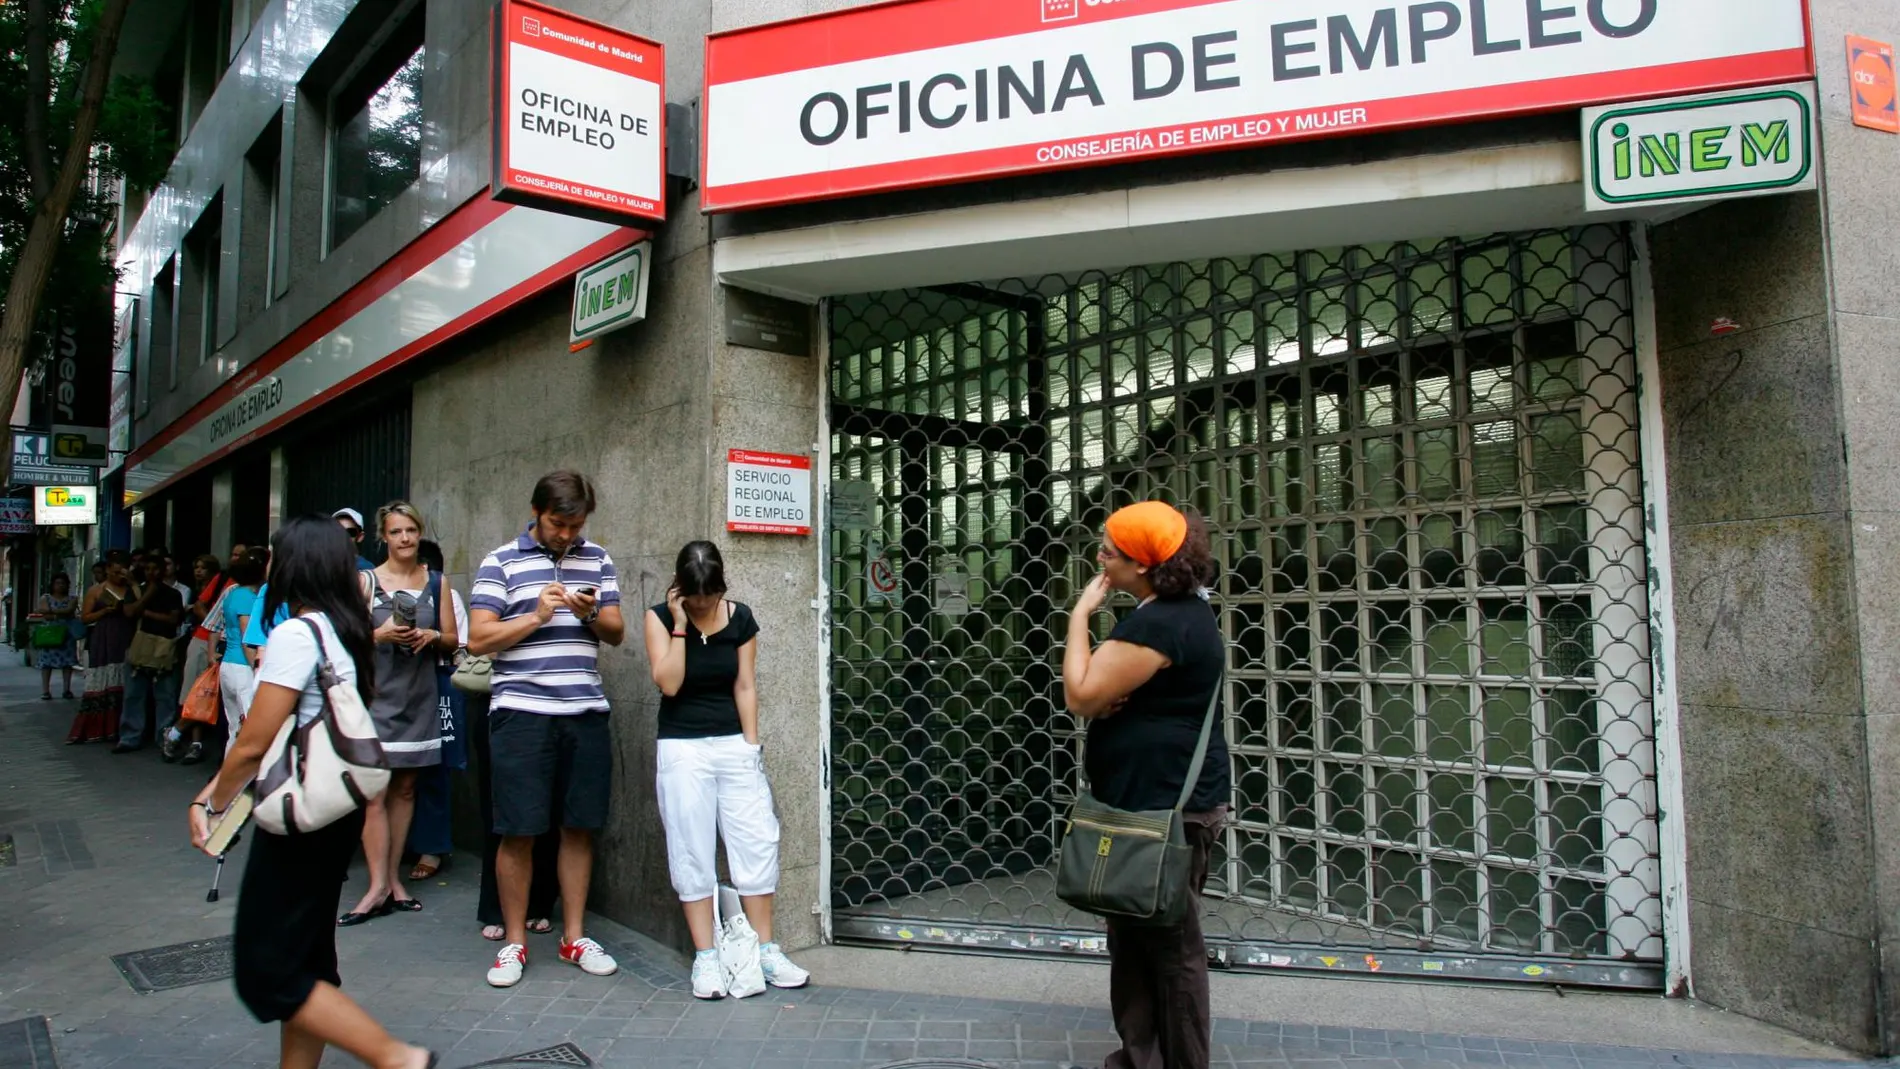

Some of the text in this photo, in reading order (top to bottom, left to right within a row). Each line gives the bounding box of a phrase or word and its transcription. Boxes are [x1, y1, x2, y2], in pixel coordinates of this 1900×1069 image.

[542, 26, 643, 63] Comunidad de Madrid
[799, 0, 1658, 146] OFICINA DE EMPLEO
[521, 88, 648, 136] OFICINA DE
[521, 111, 615, 150] EMPLEO
[1036, 107, 1367, 163] CONSEJERÍA DE EMPLEO Y MUJER
[515, 175, 654, 210] CONSEJERÍA DE EMPLEO Y MUJER
[237, 400, 248, 427] DE
[248, 377, 283, 421] EMPLEO
[13, 472, 50, 481] HOMBRE
[60, 474, 89, 483] MUJER
[735, 469, 791, 485] SERVICIO
[735, 487, 797, 503] REGIONAL
[735, 505, 804, 521] DE EMPLEO
